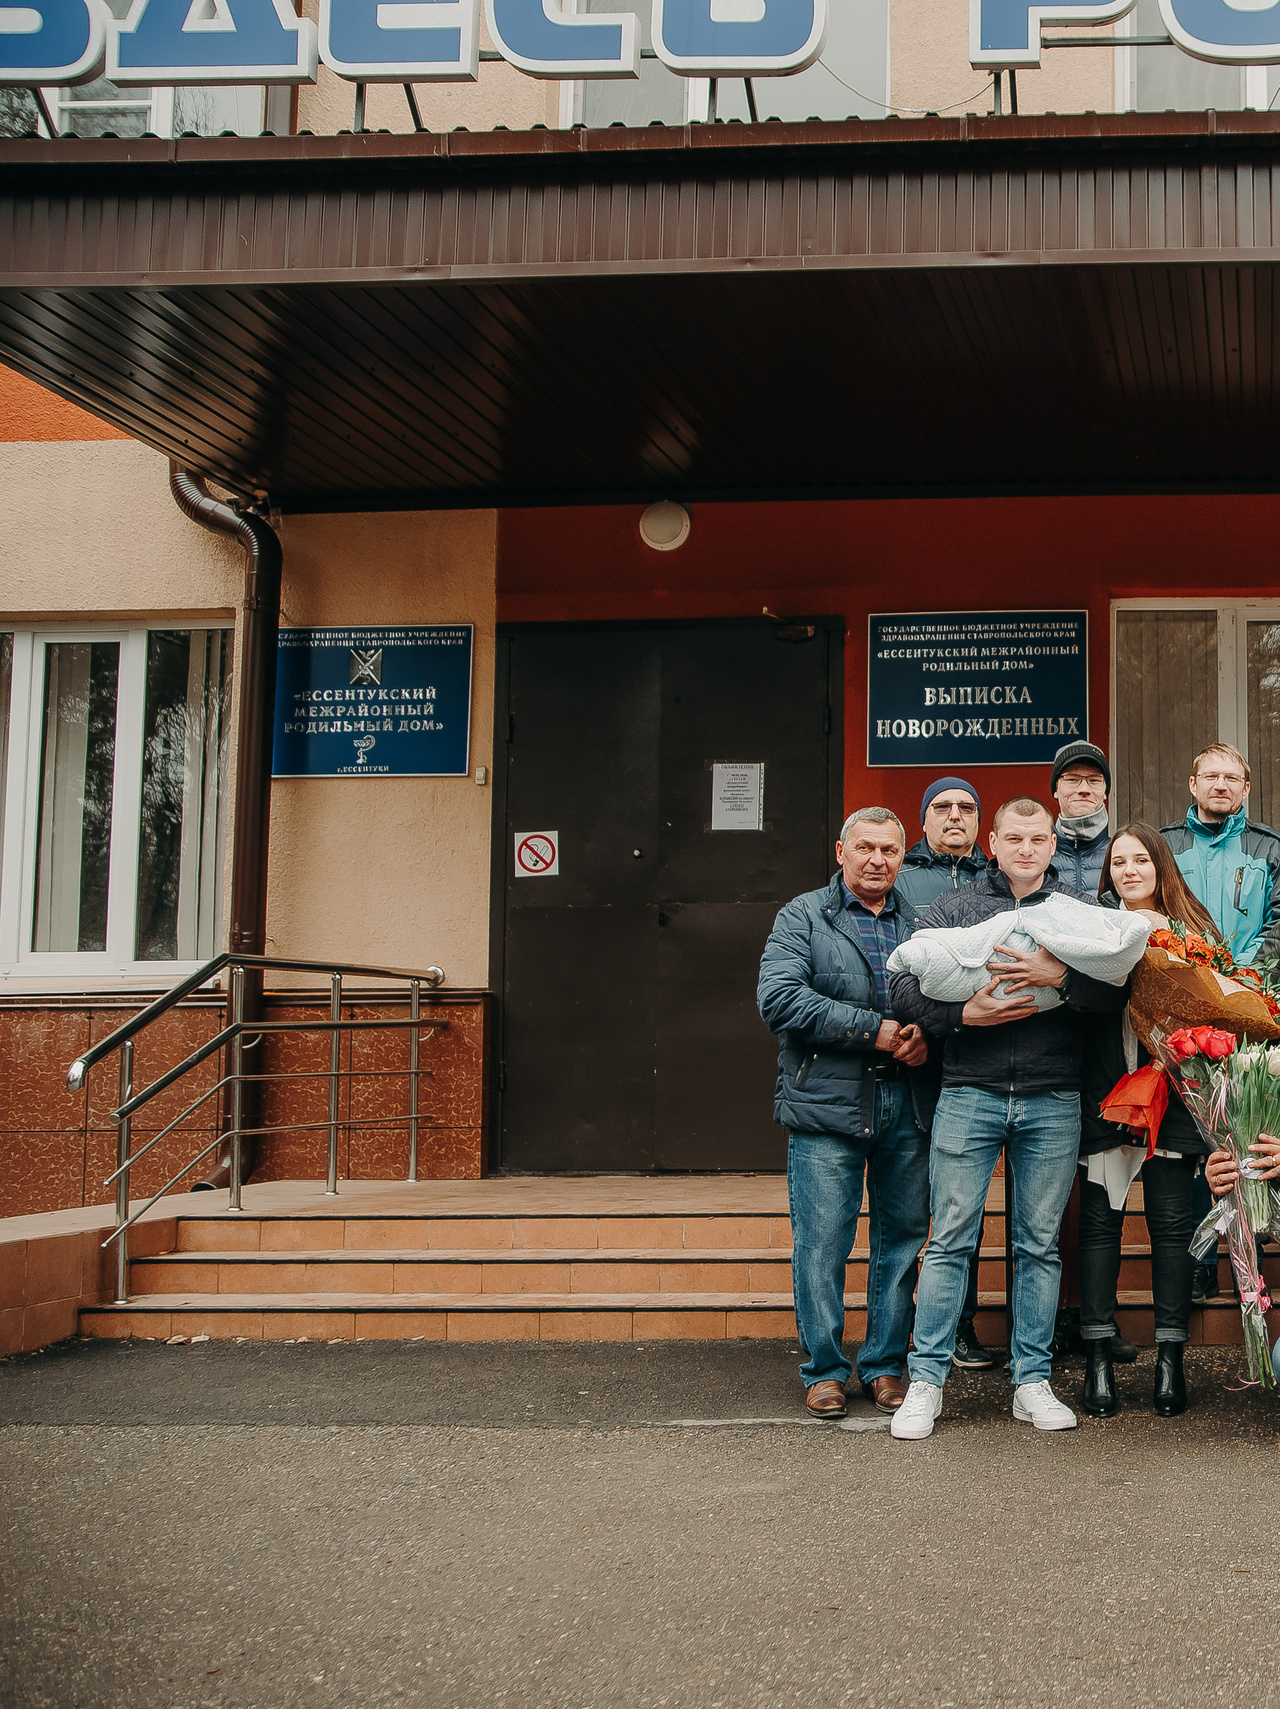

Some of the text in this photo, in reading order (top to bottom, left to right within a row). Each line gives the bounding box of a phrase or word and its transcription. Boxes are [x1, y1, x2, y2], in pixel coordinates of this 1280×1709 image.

[878, 622, 1079, 633] ГОСУДАРСТВЕННОЕ БЮДЖЕТНОЕ УЧРЕЖДЕНИЕ
[278, 630, 467, 640] СУДАРСТВЕННОЕ БЮДЖЕТНОЕ УЧРЕЖДЕНИЕ
[881, 630, 1076, 642] ЗДРАВООХРАНЕНИЯ СТАВРОПОЛЬСКОГО КРАЯ
[278, 640, 354, 648] ДРАВООХРАНЕНИЯ
[355, 639, 440, 647] СТАВРОПОЛЬСКОГО
[877, 645, 1079, 659] «ЕССЕНТУКСКИЙ МЕЖРАЙОННЫЙ
[922, 659, 1034, 672] РОДИЛЬНЫЙ ДОМ»
[293, 686, 436, 701] «ЕССЕНТУКСКИЙ
[924, 685, 1032, 706] ВЫПИСКА
[294, 702, 434, 717] МЕЖРАЙОННЫЙ
[284, 718, 444, 734] РОДИЛЬНЫЙ ДОМ»
[876, 717, 1080, 740] НОВОРОЖДЕННЫХ
